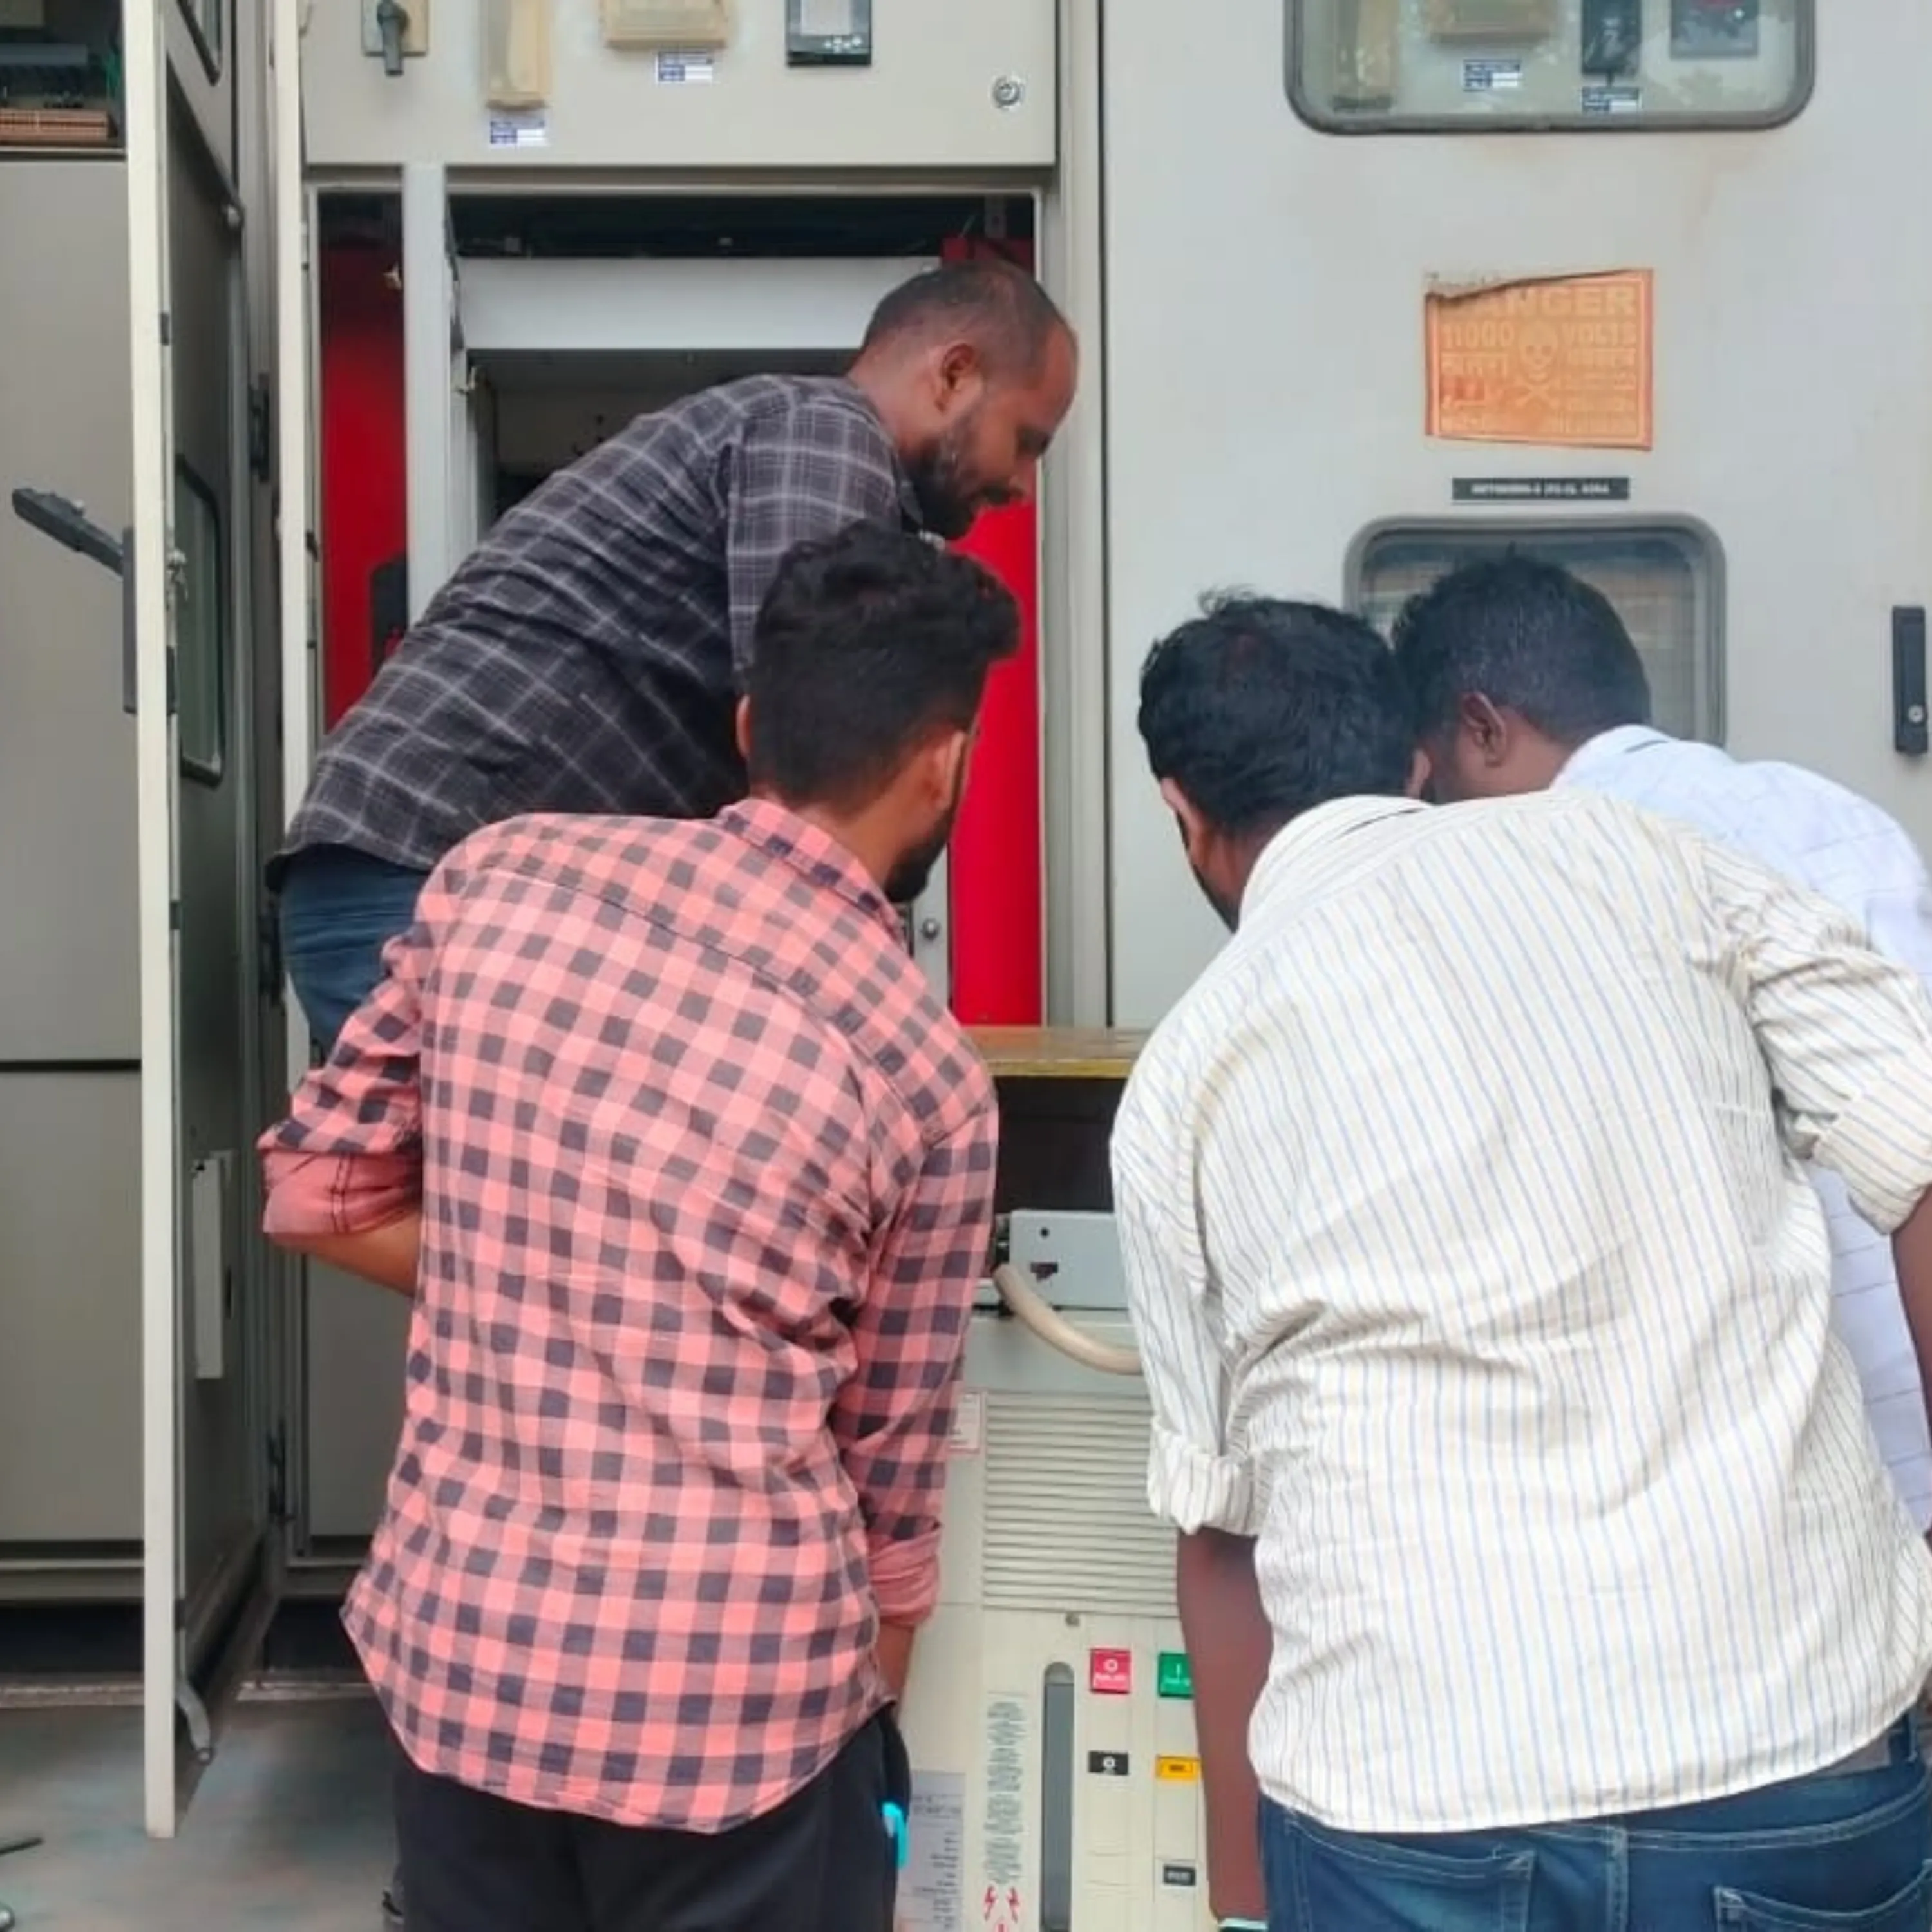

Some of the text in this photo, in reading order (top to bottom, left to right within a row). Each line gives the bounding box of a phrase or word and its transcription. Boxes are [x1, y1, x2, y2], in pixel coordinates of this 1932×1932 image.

[1443, 287, 1636, 316] ANGER
[1441, 320, 1637, 349] 11000 VOLTS
